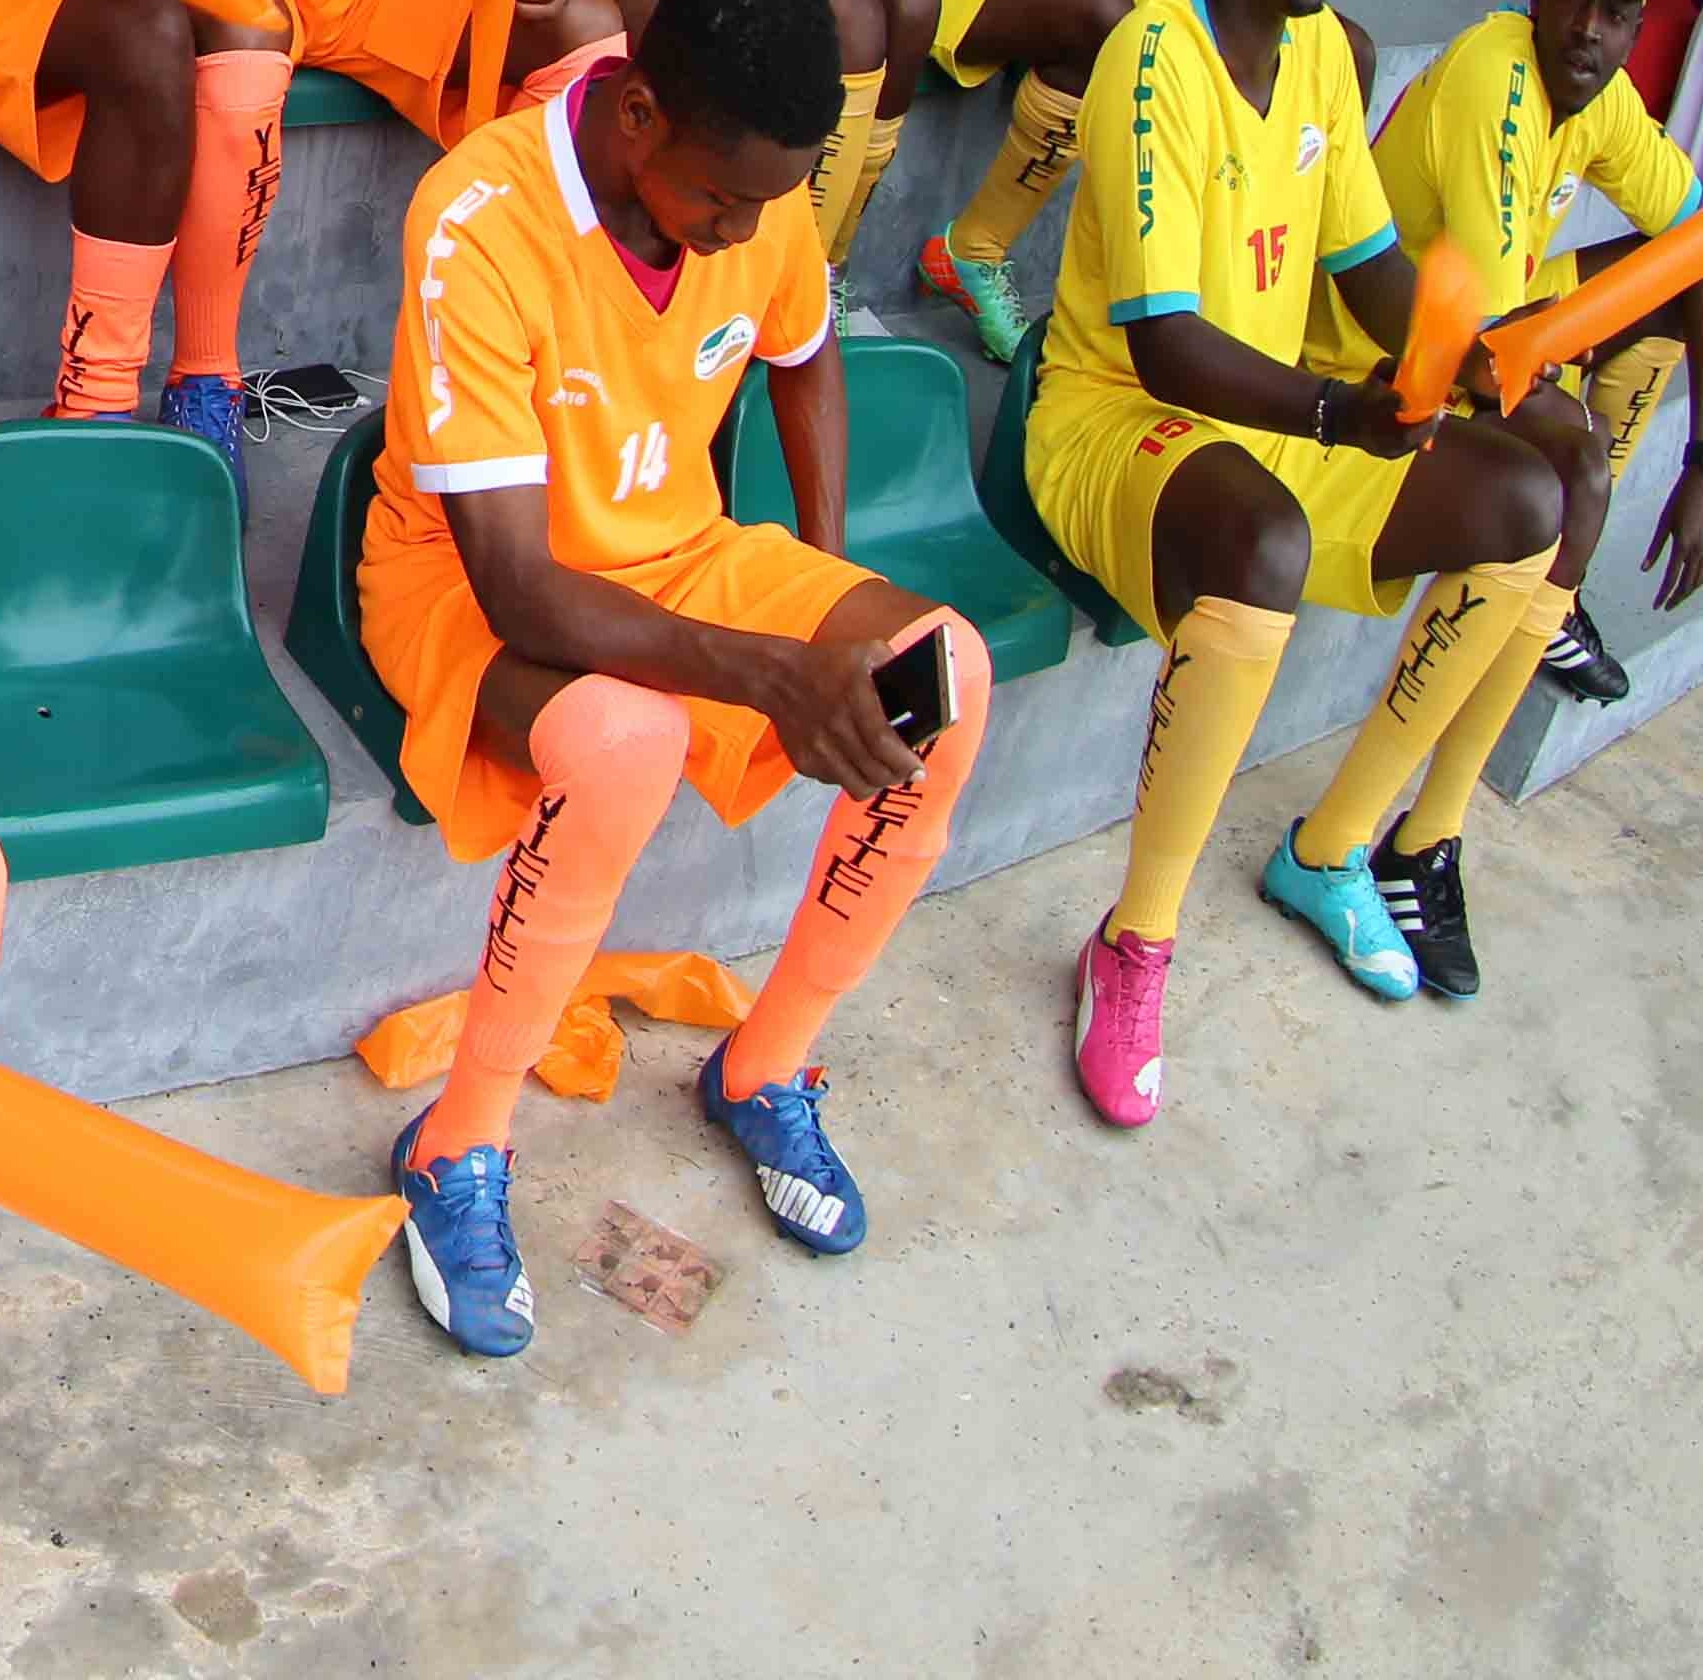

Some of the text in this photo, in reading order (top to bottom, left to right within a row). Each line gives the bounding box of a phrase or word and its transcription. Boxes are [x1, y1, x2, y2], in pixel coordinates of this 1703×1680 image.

[1137, 21, 1166, 242] VIETTEL
[1497, 60, 1527, 258] VIETTEL
[419, 181, 510, 436] VIETTEL
[1246, 223, 1288, 293] 15
[610, 420, 671, 503] 14
